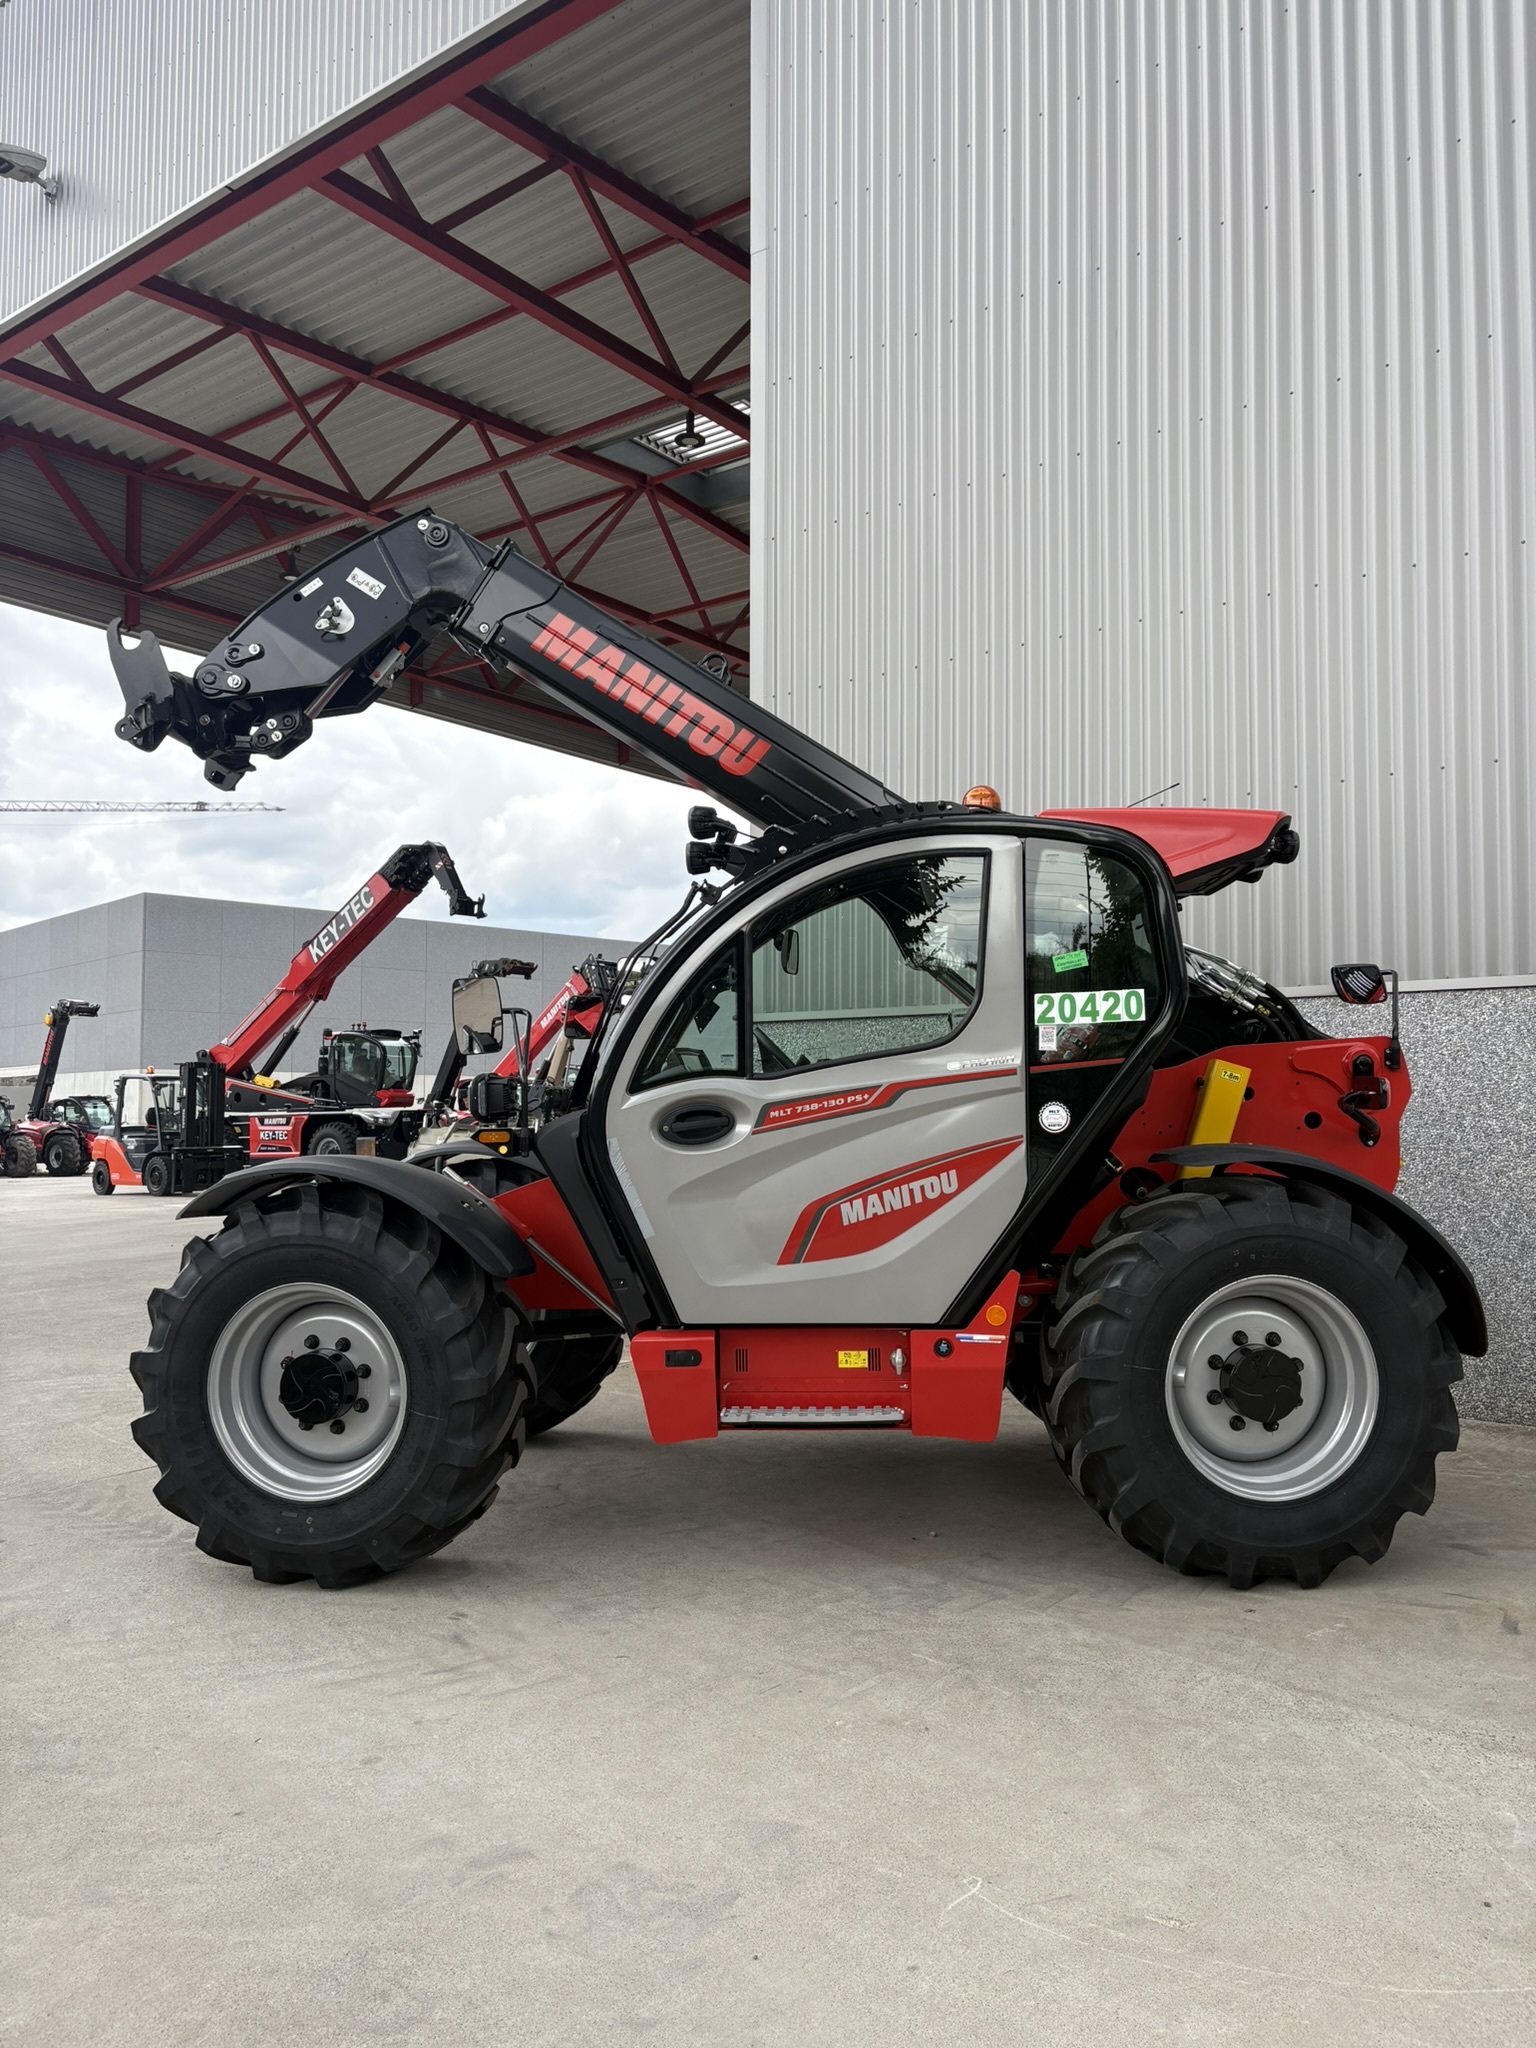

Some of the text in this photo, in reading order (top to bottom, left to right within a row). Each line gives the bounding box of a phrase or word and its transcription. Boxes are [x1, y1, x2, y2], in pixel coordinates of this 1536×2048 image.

[530, 612, 772, 777] MANITOU
[308, 884, 376, 964] KEY-TEC
[540, 990, 570, 1029] MANITOU
[1036, 990, 1143, 1023] 20420
[1223, 1071, 1240, 1081] 7-8m
[769, 1093, 870, 1118] MLT 738-130 PS+
[259, 1130, 288, 1140] KEY-TEC
[840, 1169, 959, 1226] MANITOU
